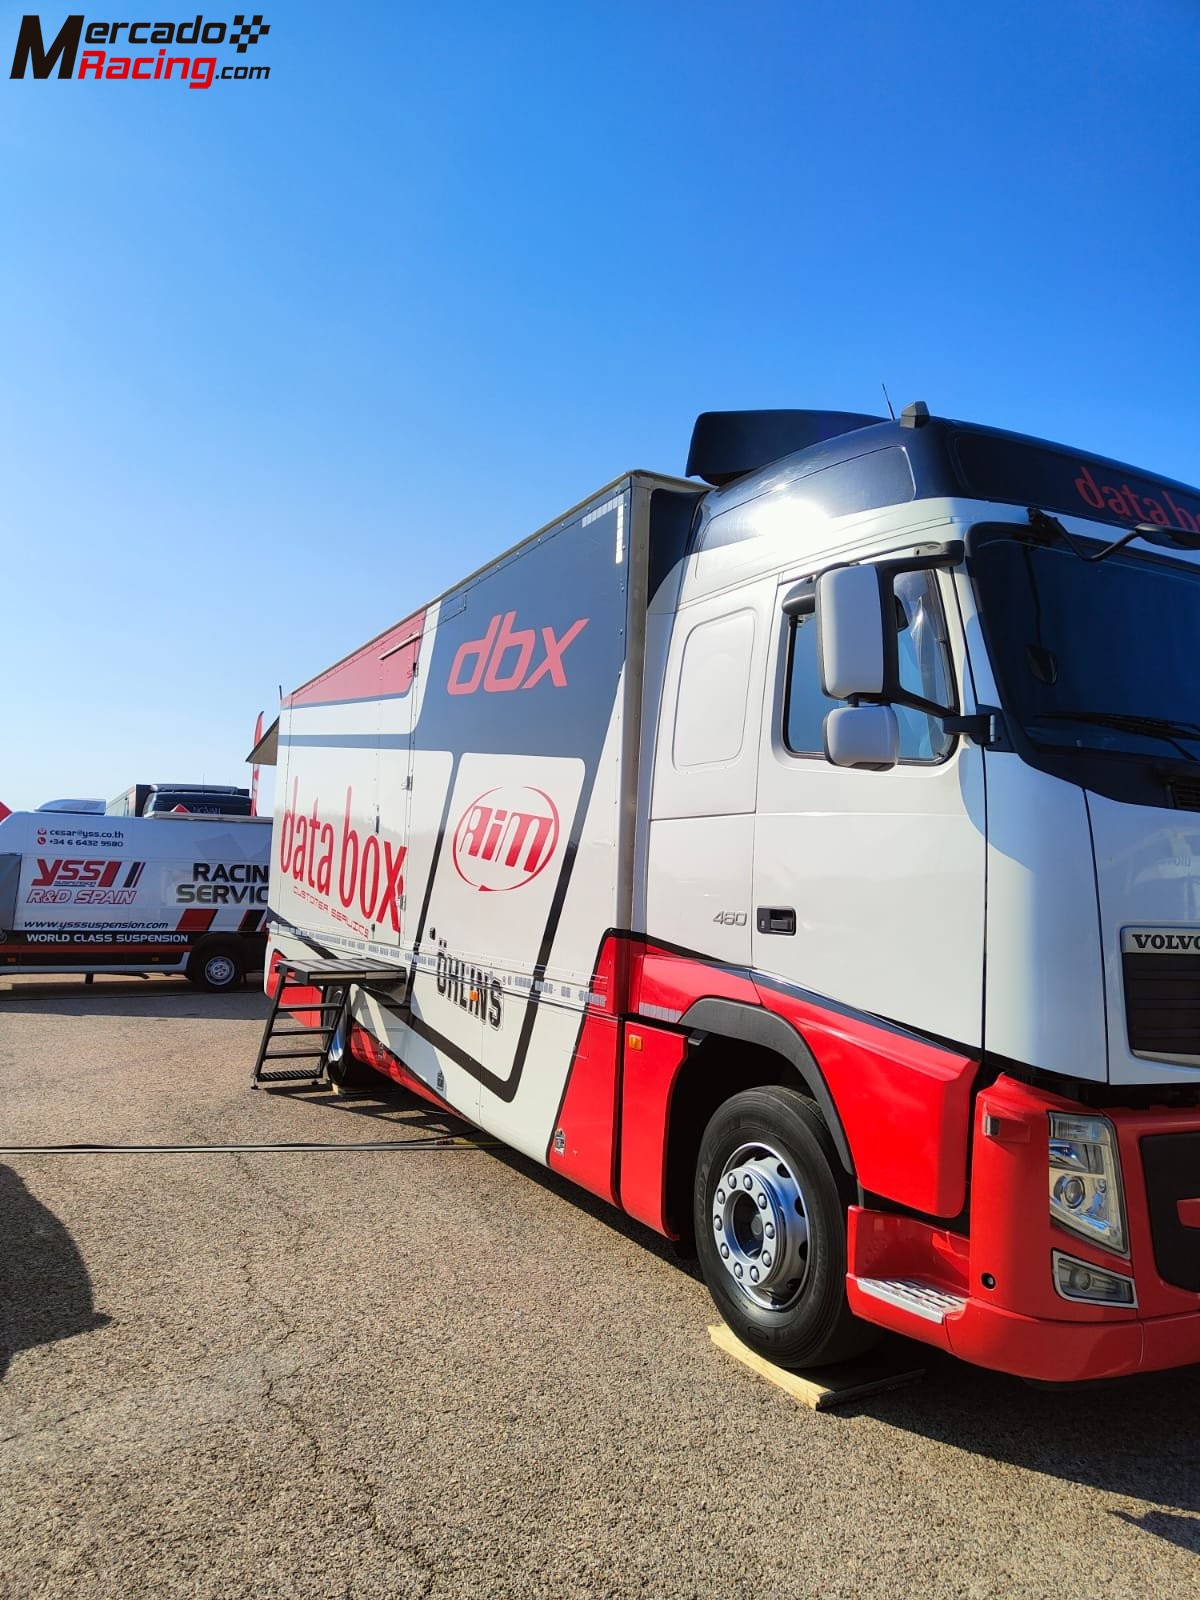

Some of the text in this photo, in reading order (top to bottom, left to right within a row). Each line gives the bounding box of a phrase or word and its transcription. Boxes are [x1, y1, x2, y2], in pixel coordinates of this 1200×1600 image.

[1074, 465, 1173, 528] data
[447, 610, 590, 695] dbx
[49, 829, 124, 839] cesar@yss.co.th
[49, 838, 65, 846] +34
[75, 839, 98, 847] 6432
[280, 775, 408, 934] data box
[26, 888, 137, 905] R&D SPAIN
[24, 920, 168, 930] www.ysssuspension.com
[713, 910, 748, 926] 460
[27, 934, 188, 943] WORLD CLASS SUSPENSION
